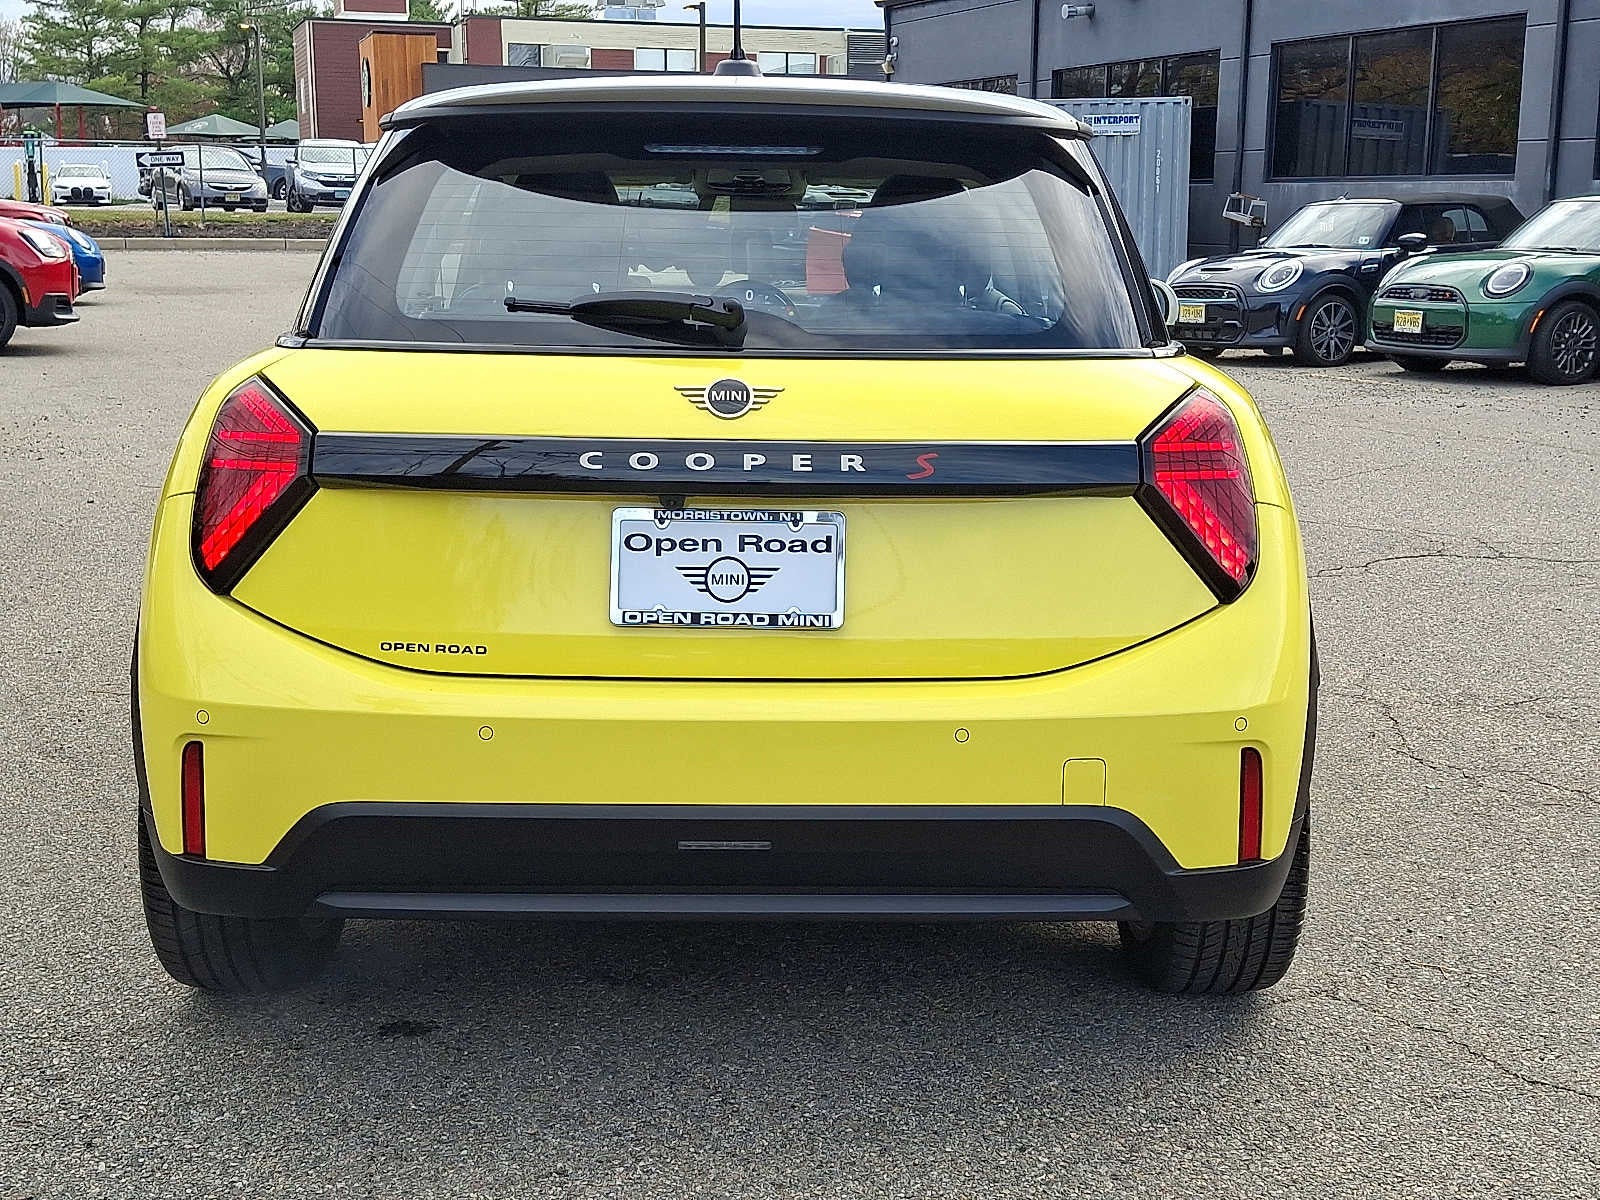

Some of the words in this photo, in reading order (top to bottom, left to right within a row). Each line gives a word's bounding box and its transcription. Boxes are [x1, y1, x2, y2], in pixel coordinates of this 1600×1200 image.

[1093, 115, 1140, 125] INTERPORT
[745, 289, 754, 301] 0
[710, 390, 748, 403] MINI
[579, 451, 867, 472] COOPER
[905, 452, 940, 480] S
[623, 532, 723, 557] Open
[738, 534, 834, 554] Road
[711, 573, 746, 586] MINI
[623, 610, 693, 625] OPEN
[700, 612, 771, 627] ROAD
[777, 614, 832, 627] MINI
[380, 641, 431, 654] OPEN
[435, 644, 489, 655] ROAD
